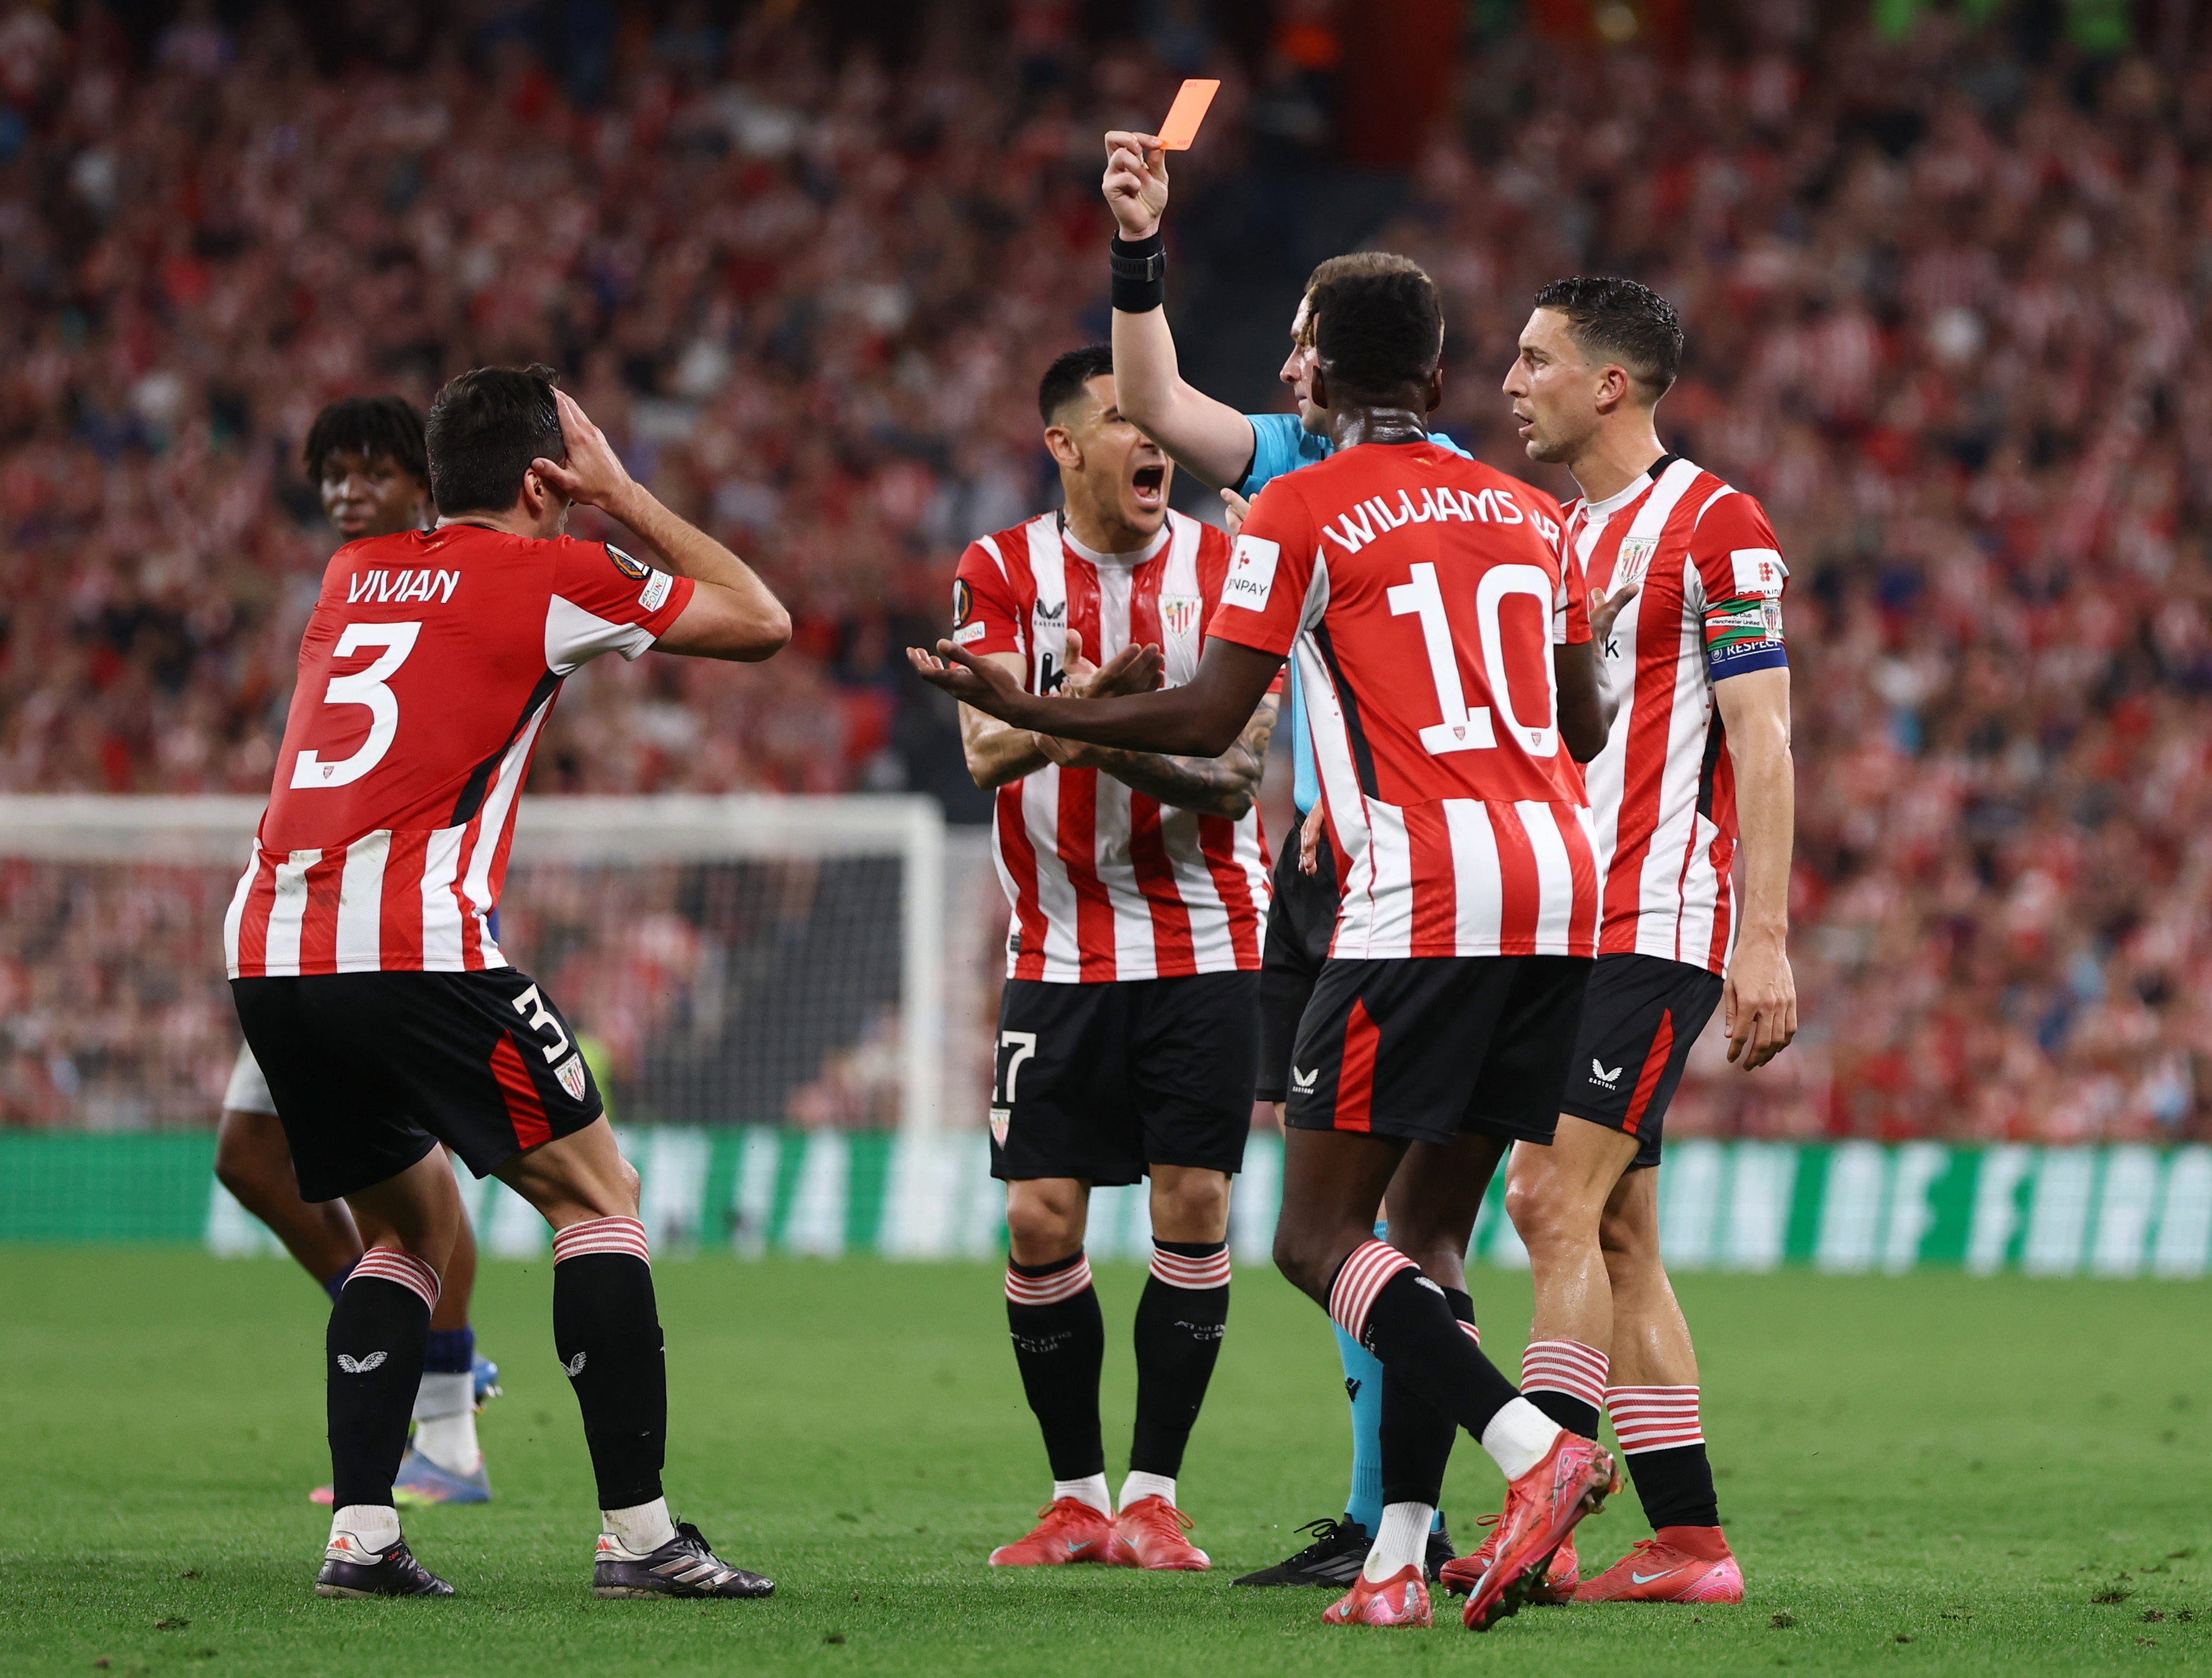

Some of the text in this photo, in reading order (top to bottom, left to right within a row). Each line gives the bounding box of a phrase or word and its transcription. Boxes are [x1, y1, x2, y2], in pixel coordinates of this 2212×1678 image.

[1322, 486, 1524, 554] WILLIAMS
[347, 568, 461, 605] VIVIAN
[1386, 561, 1559, 758] 10
[288, 621, 423, 790] 3
[511, 983, 569, 1064] 3
[1588, 1077, 1617, 1091] CASTORE
